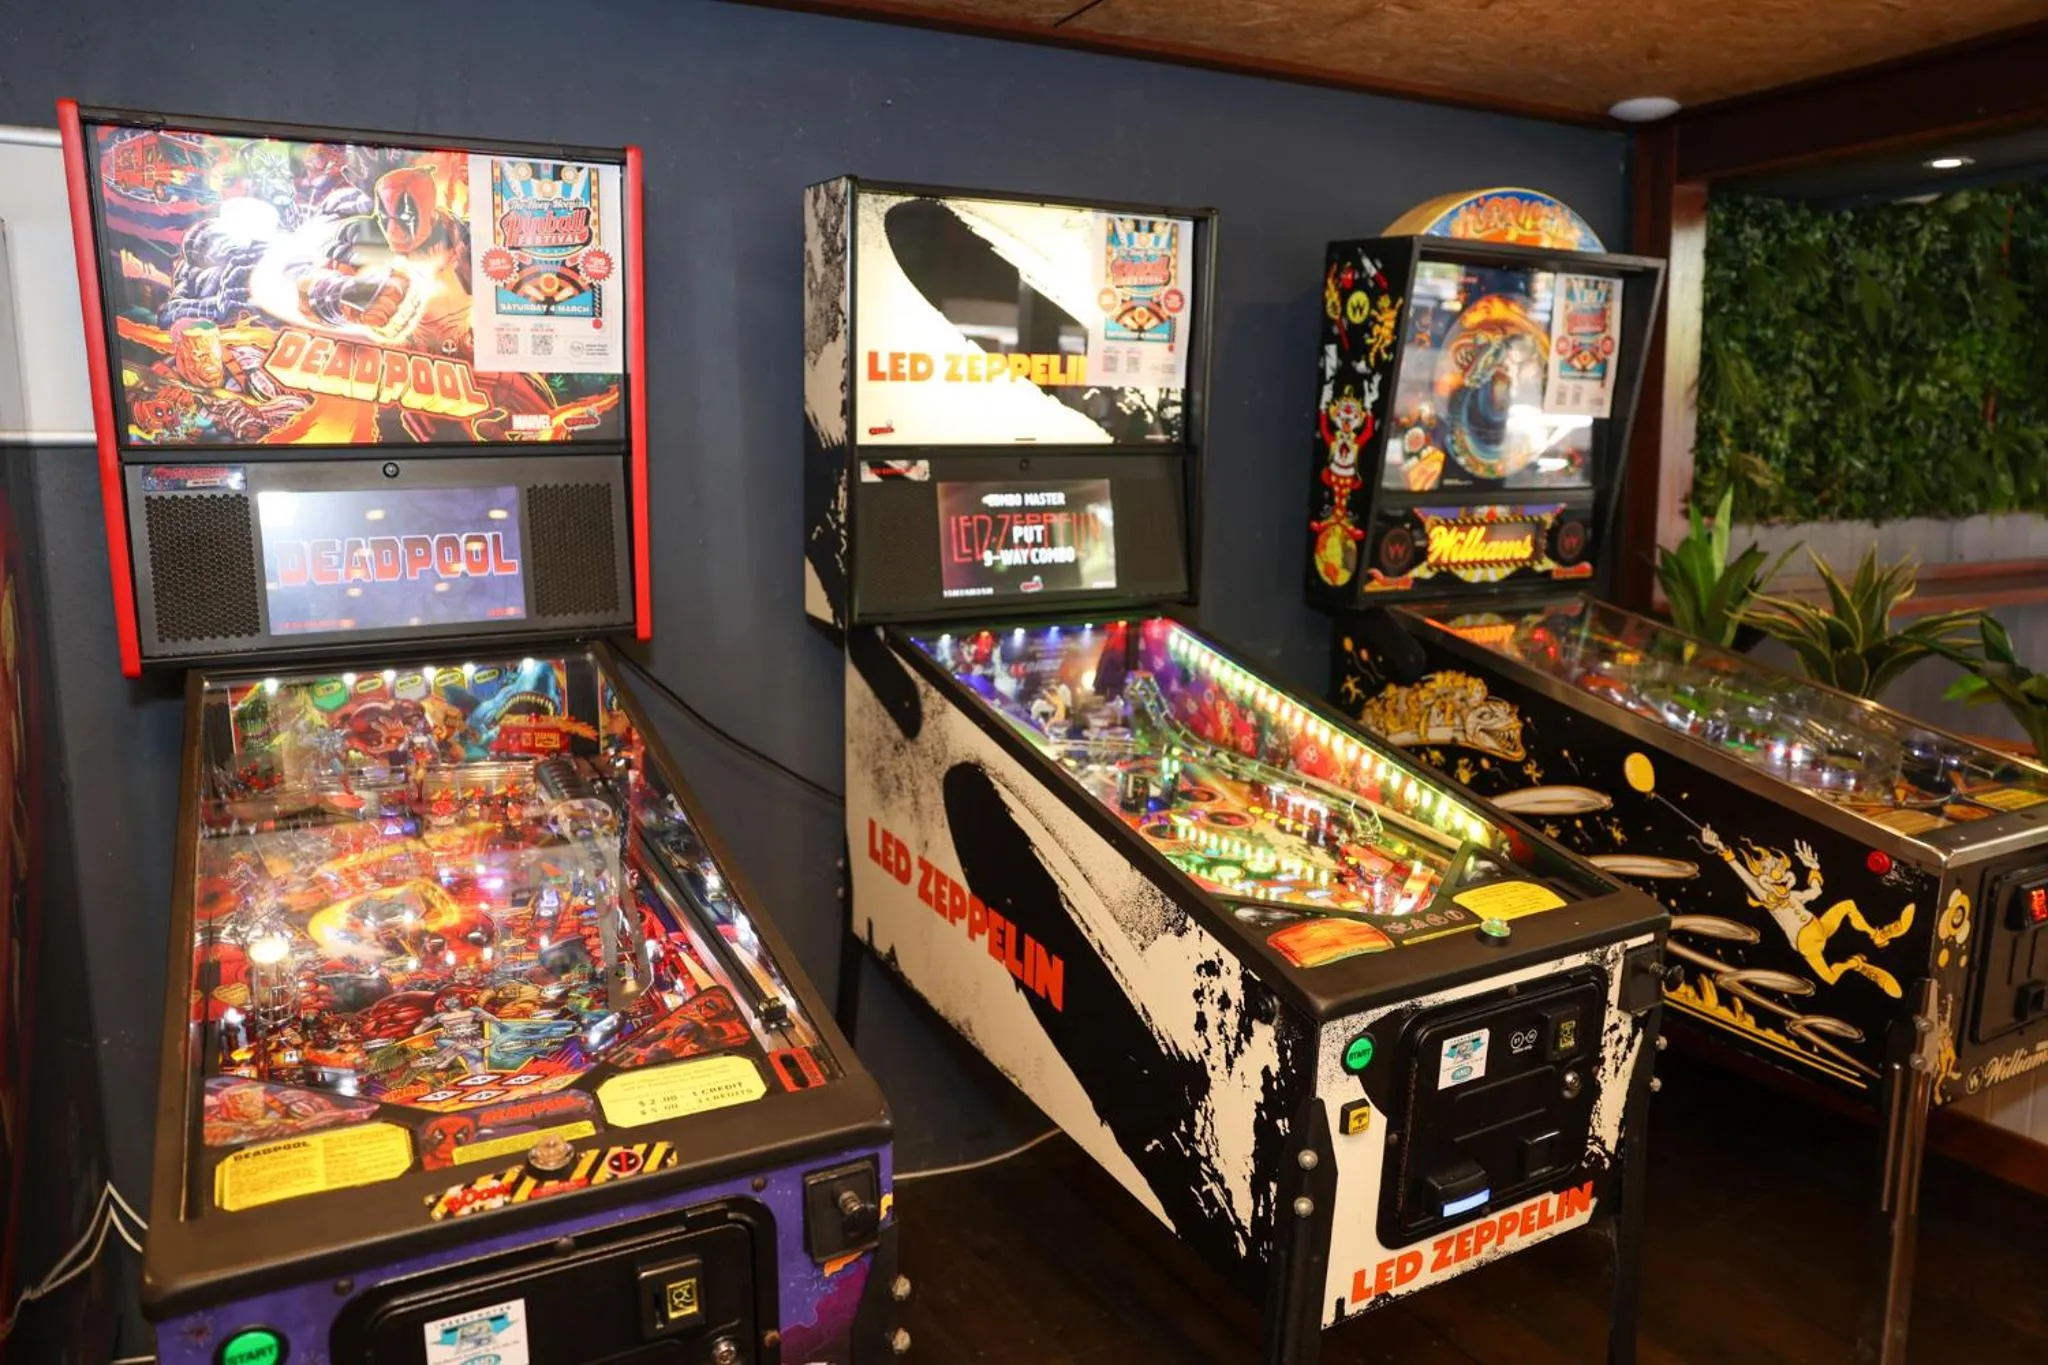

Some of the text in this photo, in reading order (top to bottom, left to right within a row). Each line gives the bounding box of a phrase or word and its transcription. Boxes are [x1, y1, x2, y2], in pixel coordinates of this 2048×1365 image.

[519, 233, 579, 244] FESTIVAL
[500, 303, 546, 312] SATURDAY
[265, 330, 489, 415] DEADPOOL
[868, 351, 934, 382] LED
[1024, 492, 1066, 506] MASTER
[1012, 525, 1045, 543] PUT
[1427, 524, 1535, 563] Williams
[274, 533, 519, 587] DEADPOOL
[1030, 547, 1076, 565] COMBO
[868, 817, 1064, 1012] LED ZEPPELIN
[1348, 1047, 1372, 1062] START
[701, 1082, 744, 1096] CREDIT
[233, 1141, 312, 1162] DEADPOOL
[1351, 1180, 1594, 1304] LED ZEPPELIN
[226, 1345, 275, 1365] START
